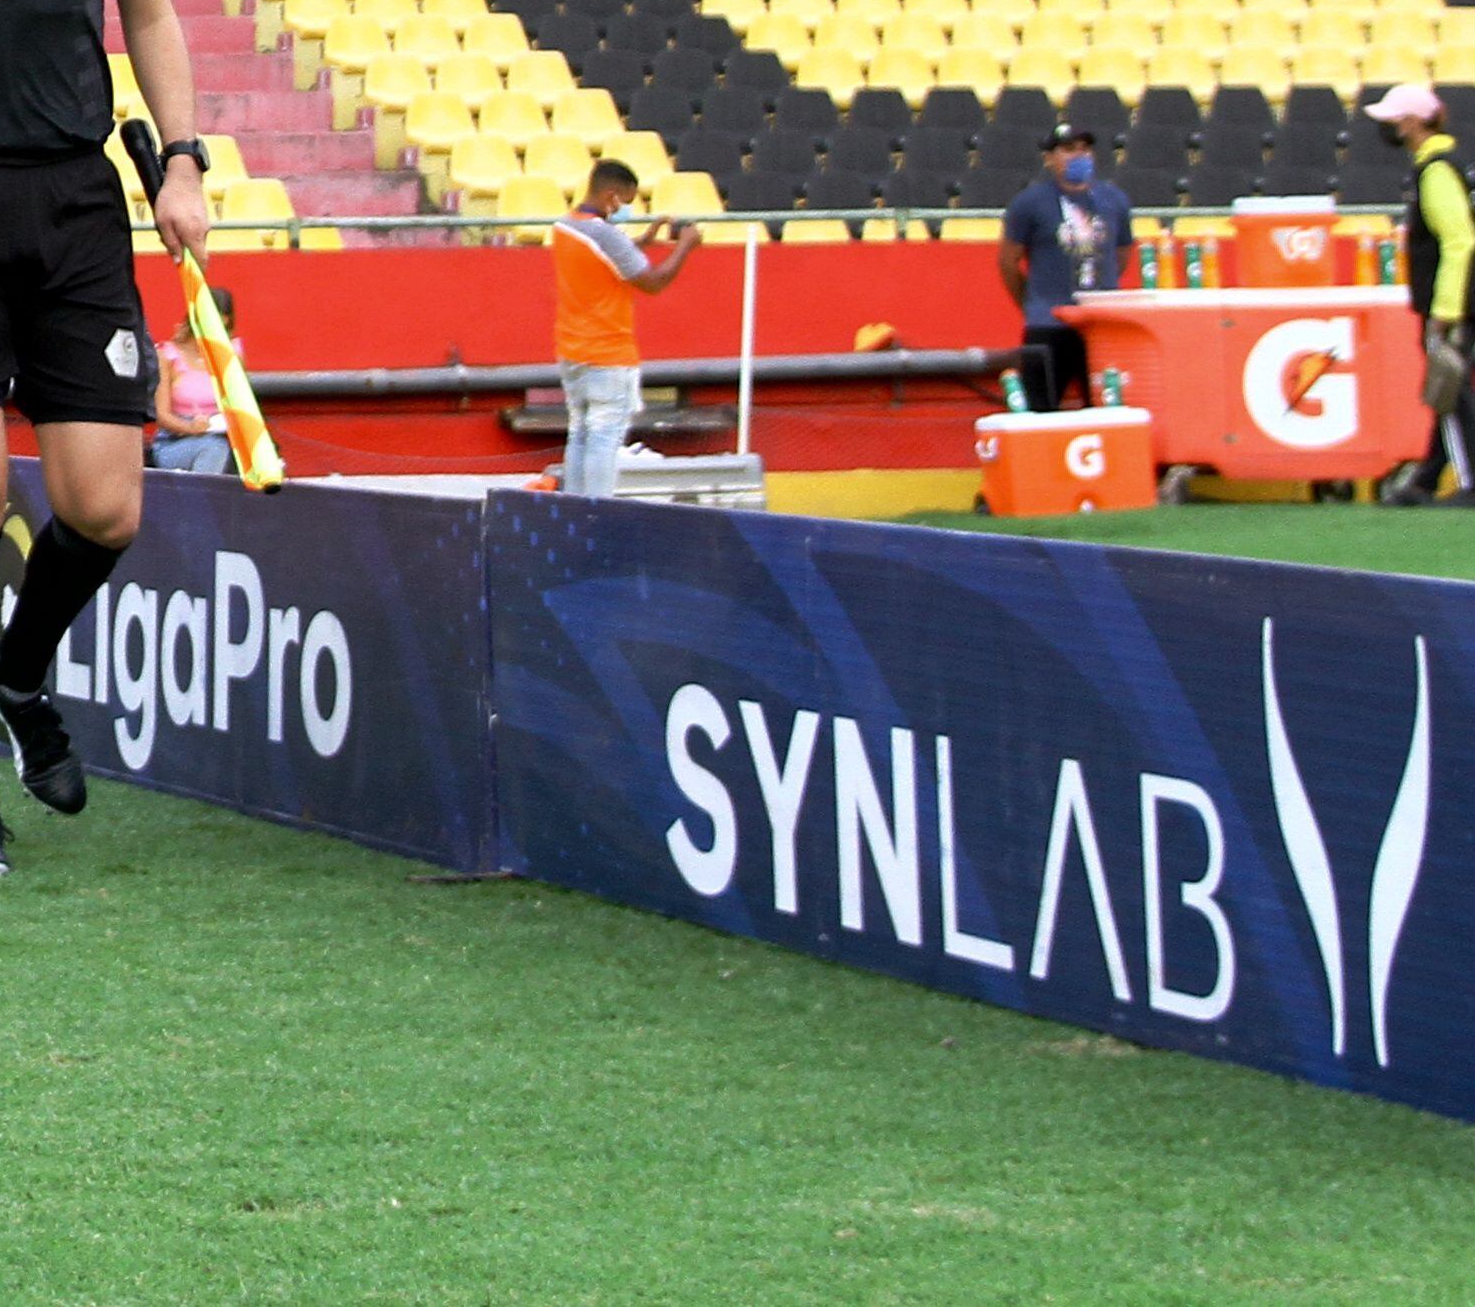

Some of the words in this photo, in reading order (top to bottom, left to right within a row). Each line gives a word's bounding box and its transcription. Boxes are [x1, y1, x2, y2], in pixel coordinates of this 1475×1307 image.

[1243, 317, 1360, 449] G
[1065, 433, 1106, 479] G
[666, 684, 1236, 1021] SYNLAB
